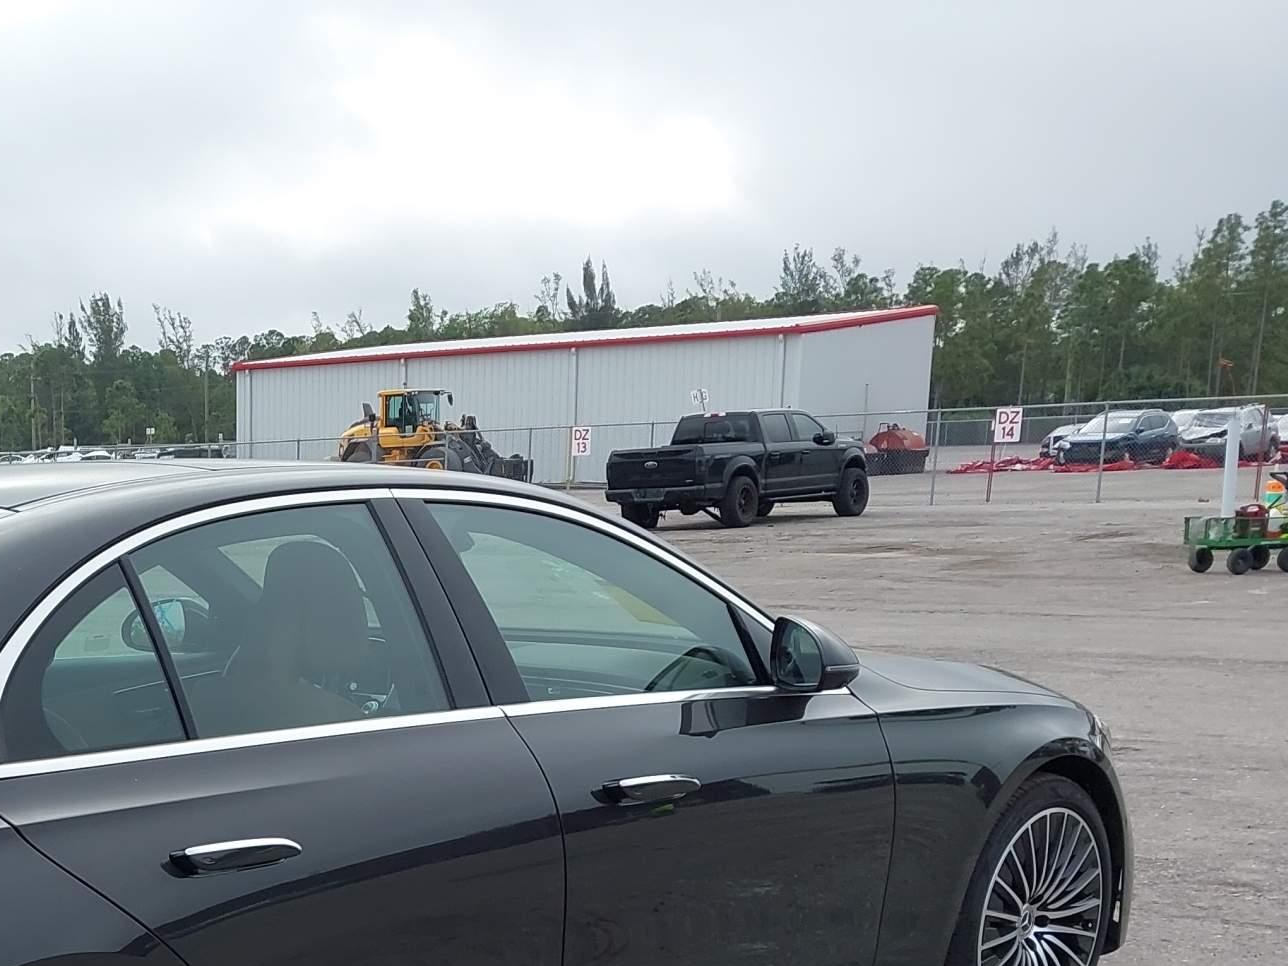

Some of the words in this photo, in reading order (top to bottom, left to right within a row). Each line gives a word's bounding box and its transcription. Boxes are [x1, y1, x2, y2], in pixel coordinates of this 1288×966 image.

[998, 410, 1020, 425] DZ
[574, 429, 590, 441] DZ
[1001, 425, 1014, 439] 14
[576, 442, 587, 454] 13
